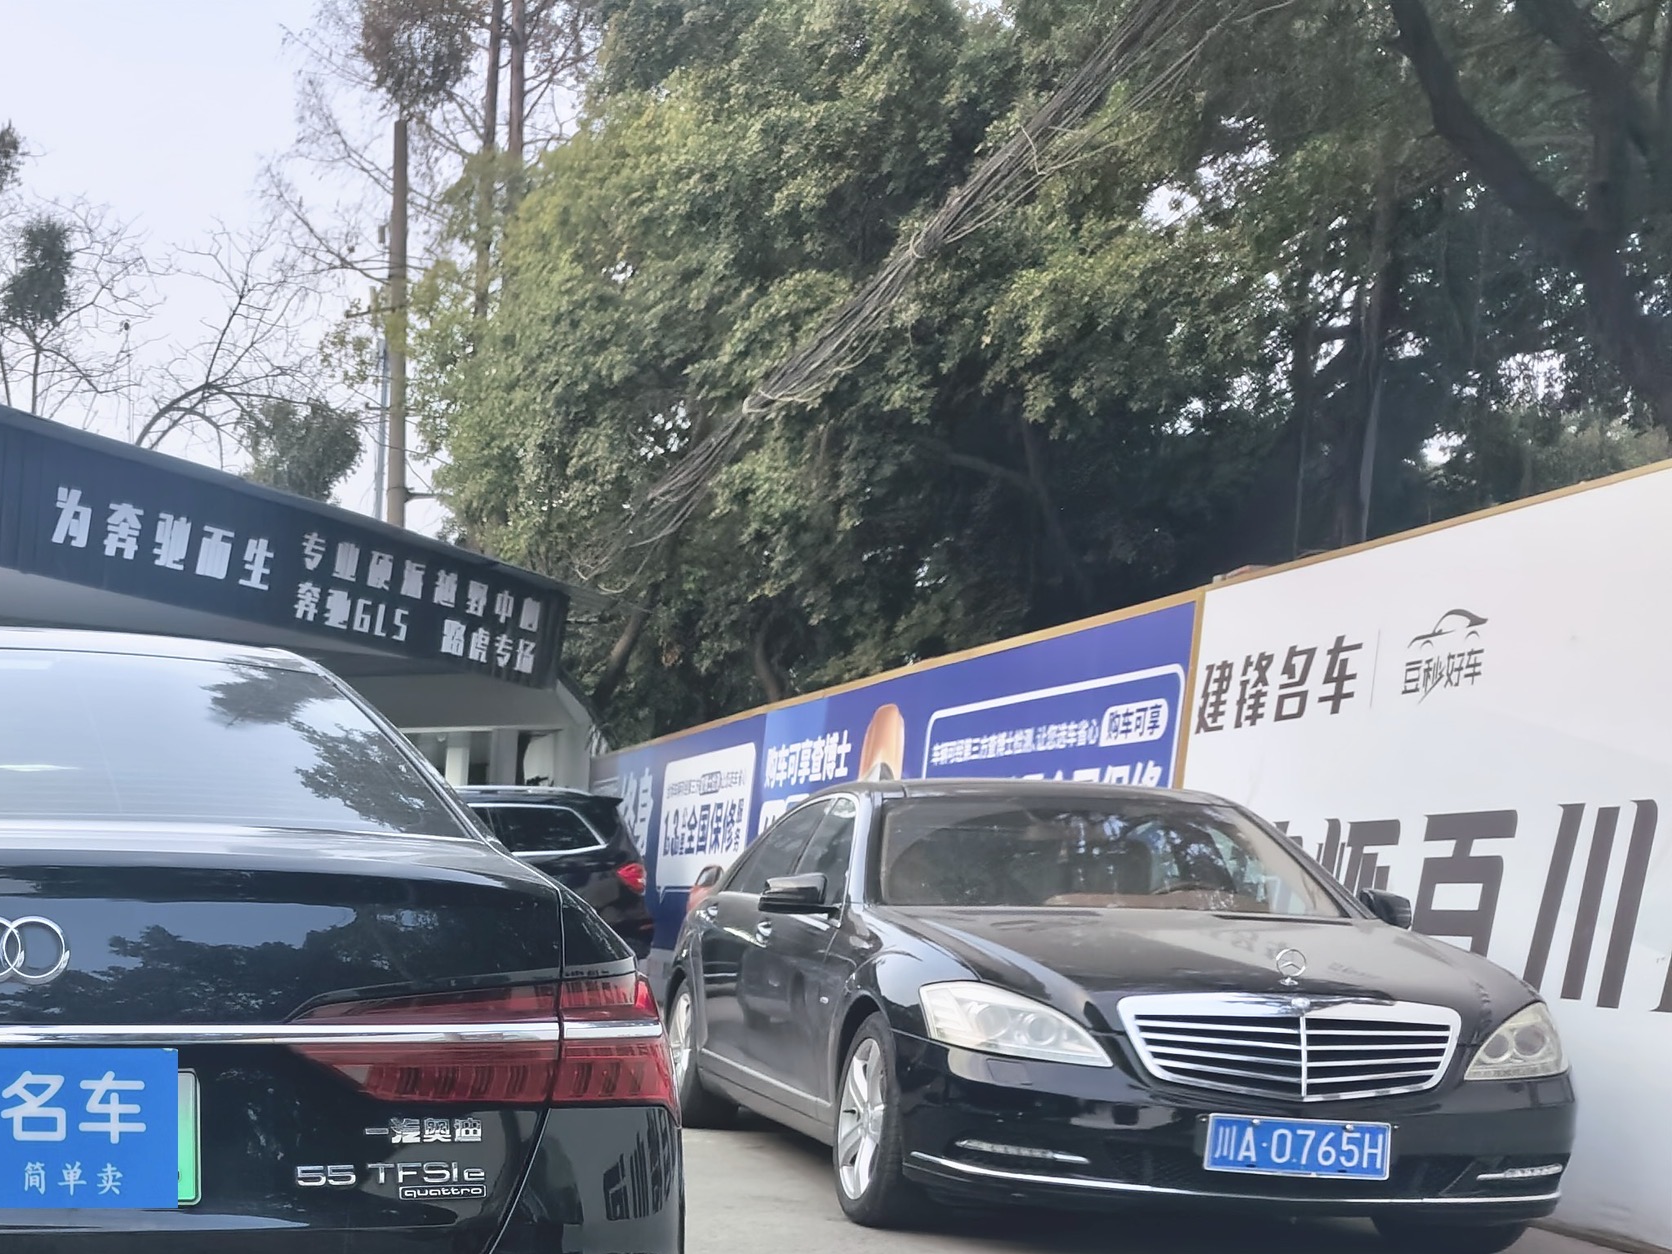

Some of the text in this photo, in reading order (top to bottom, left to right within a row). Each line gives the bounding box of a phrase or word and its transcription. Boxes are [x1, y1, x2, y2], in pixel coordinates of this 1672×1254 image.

[51, 486, 275, 592] 为奔驰而生
[1194, 634, 1363, 735] 建锋名车
[1107, 703, 1163, 741] 购车可享
[764, 728, 851, 790] 购车可享查博士
[365, 1117, 482, 1144] 一汽奥迪
[296, 1164, 357, 1187] 55
[404, 1186, 483, 1198] quattro
